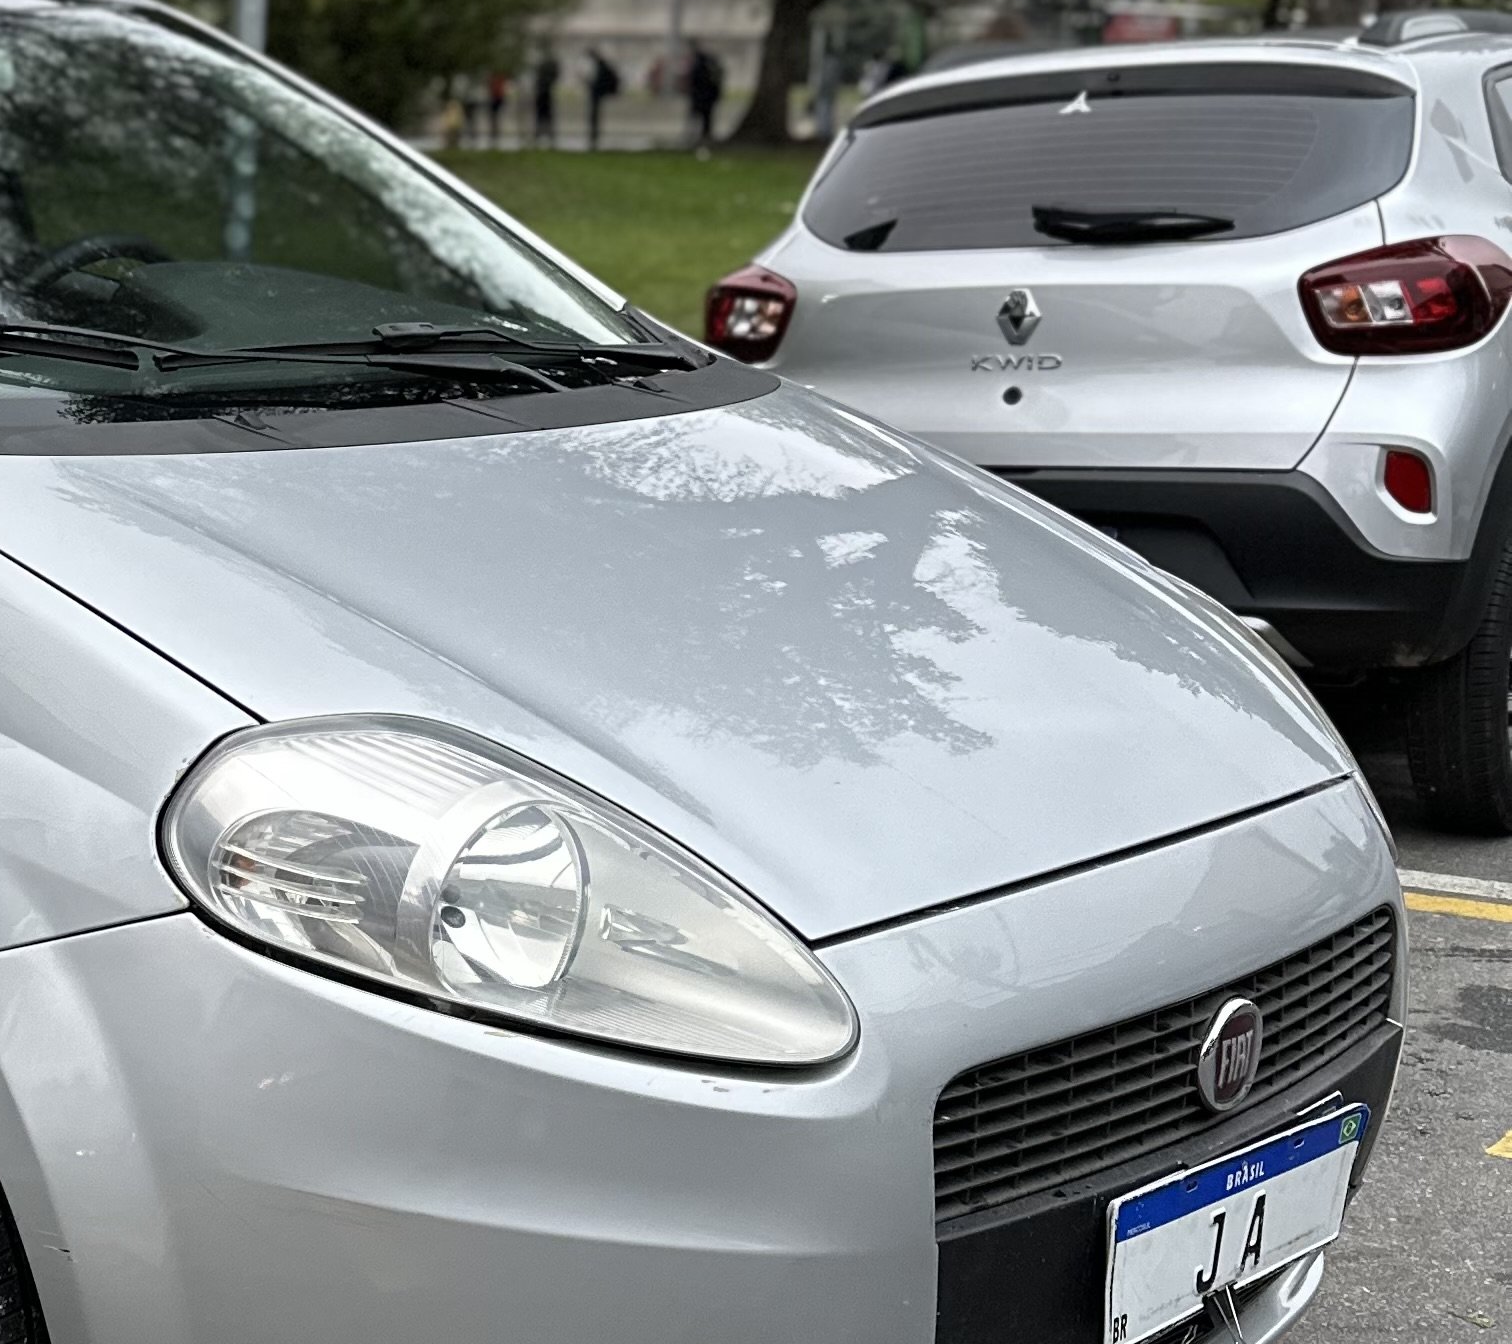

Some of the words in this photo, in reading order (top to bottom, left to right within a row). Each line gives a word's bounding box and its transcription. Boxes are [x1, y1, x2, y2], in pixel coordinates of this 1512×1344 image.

[970, 353, 1063, 372] KWID
[1217, 1029, 1254, 1089] FIAT
[1225, 1160, 1266, 1190] BRASIL
[1112, 1313, 1129, 1344] BR
